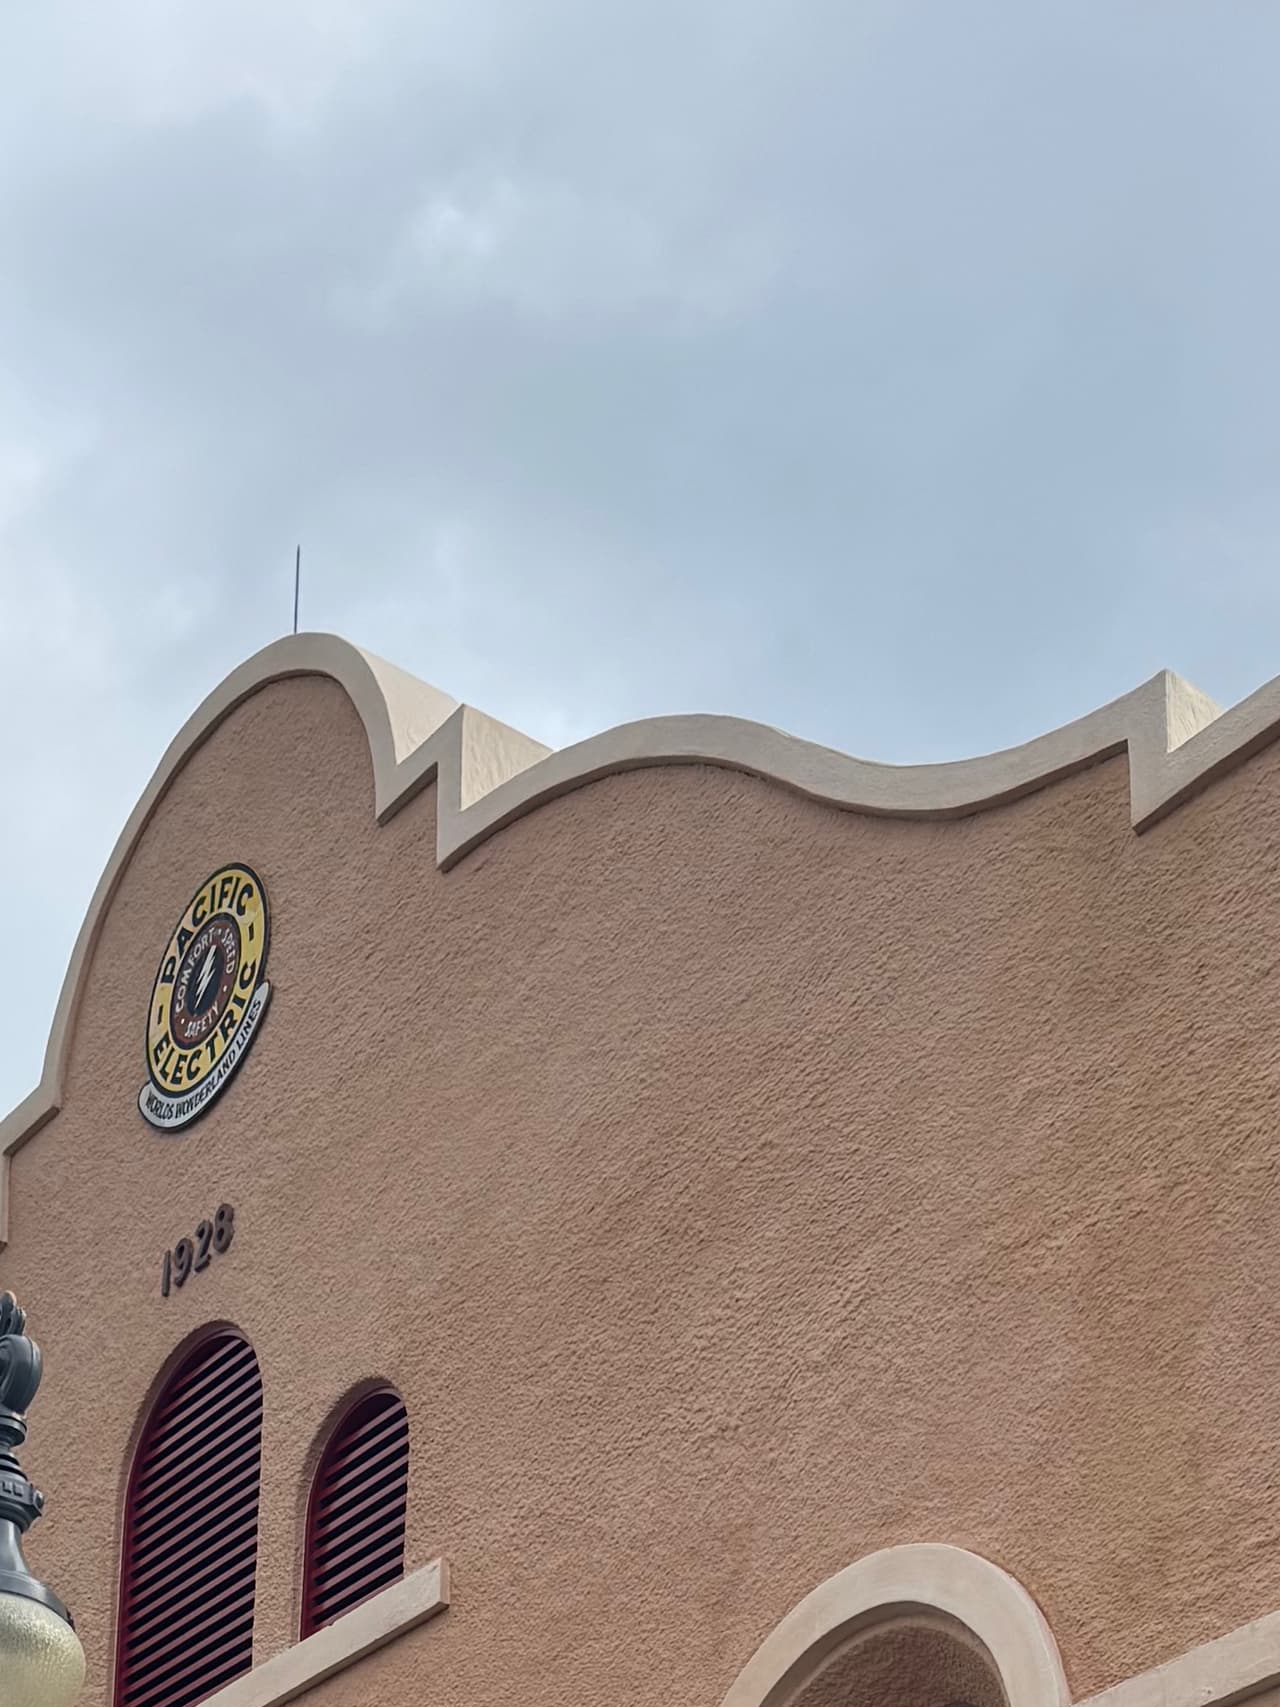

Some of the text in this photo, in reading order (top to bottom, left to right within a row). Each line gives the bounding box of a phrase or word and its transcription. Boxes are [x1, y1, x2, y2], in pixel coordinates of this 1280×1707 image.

[161, 874, 254, 986] PACIFIC
[175, 927, 215, 1016] COMFORT
[220, 927, 235, 975] SPEED
[153, 959, 257, 1086] ELECTRIC
[174, 1051, 238, 1120] WONDERLAND
[236, 998, 262, 1053] LINES
[184, 1000, 221, 1039] SAFETY
[160, 1203, 235, 1298] 1928
